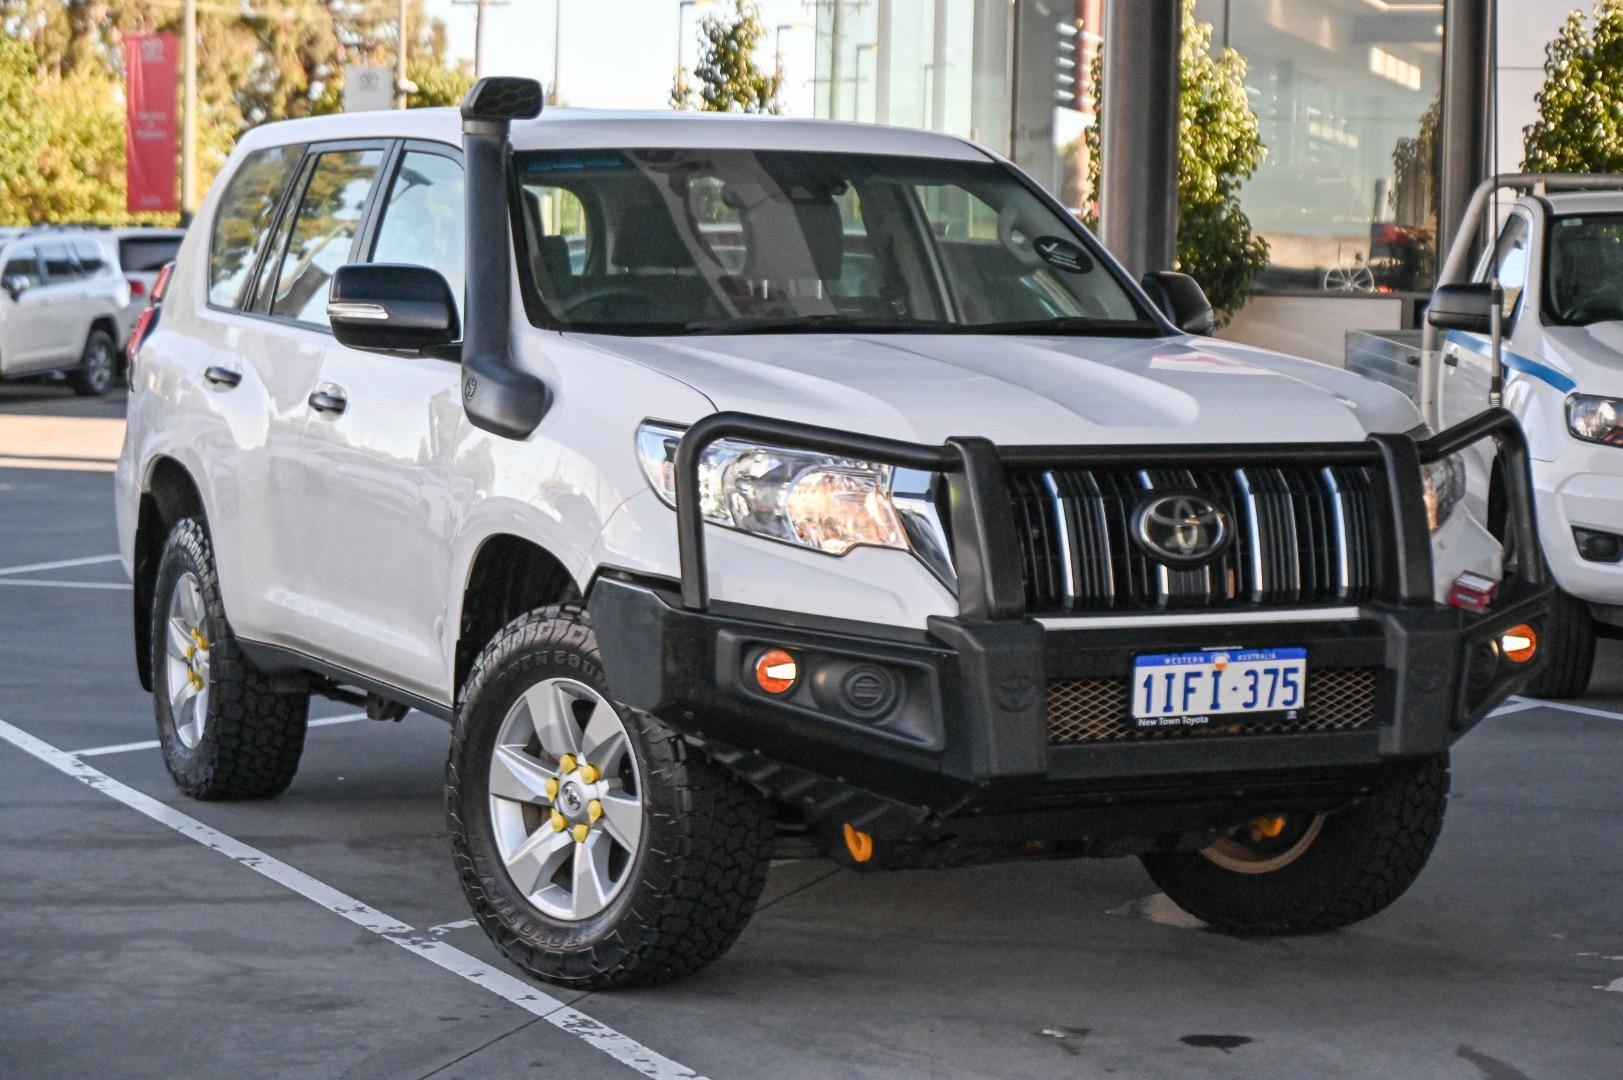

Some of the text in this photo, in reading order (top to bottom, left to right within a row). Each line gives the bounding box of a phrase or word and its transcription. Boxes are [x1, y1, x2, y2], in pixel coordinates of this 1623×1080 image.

[1165, 652, 1277, 665] WESTERN AUSTRALIA
[1138, 715, 1209, 727] New Town Toyota
